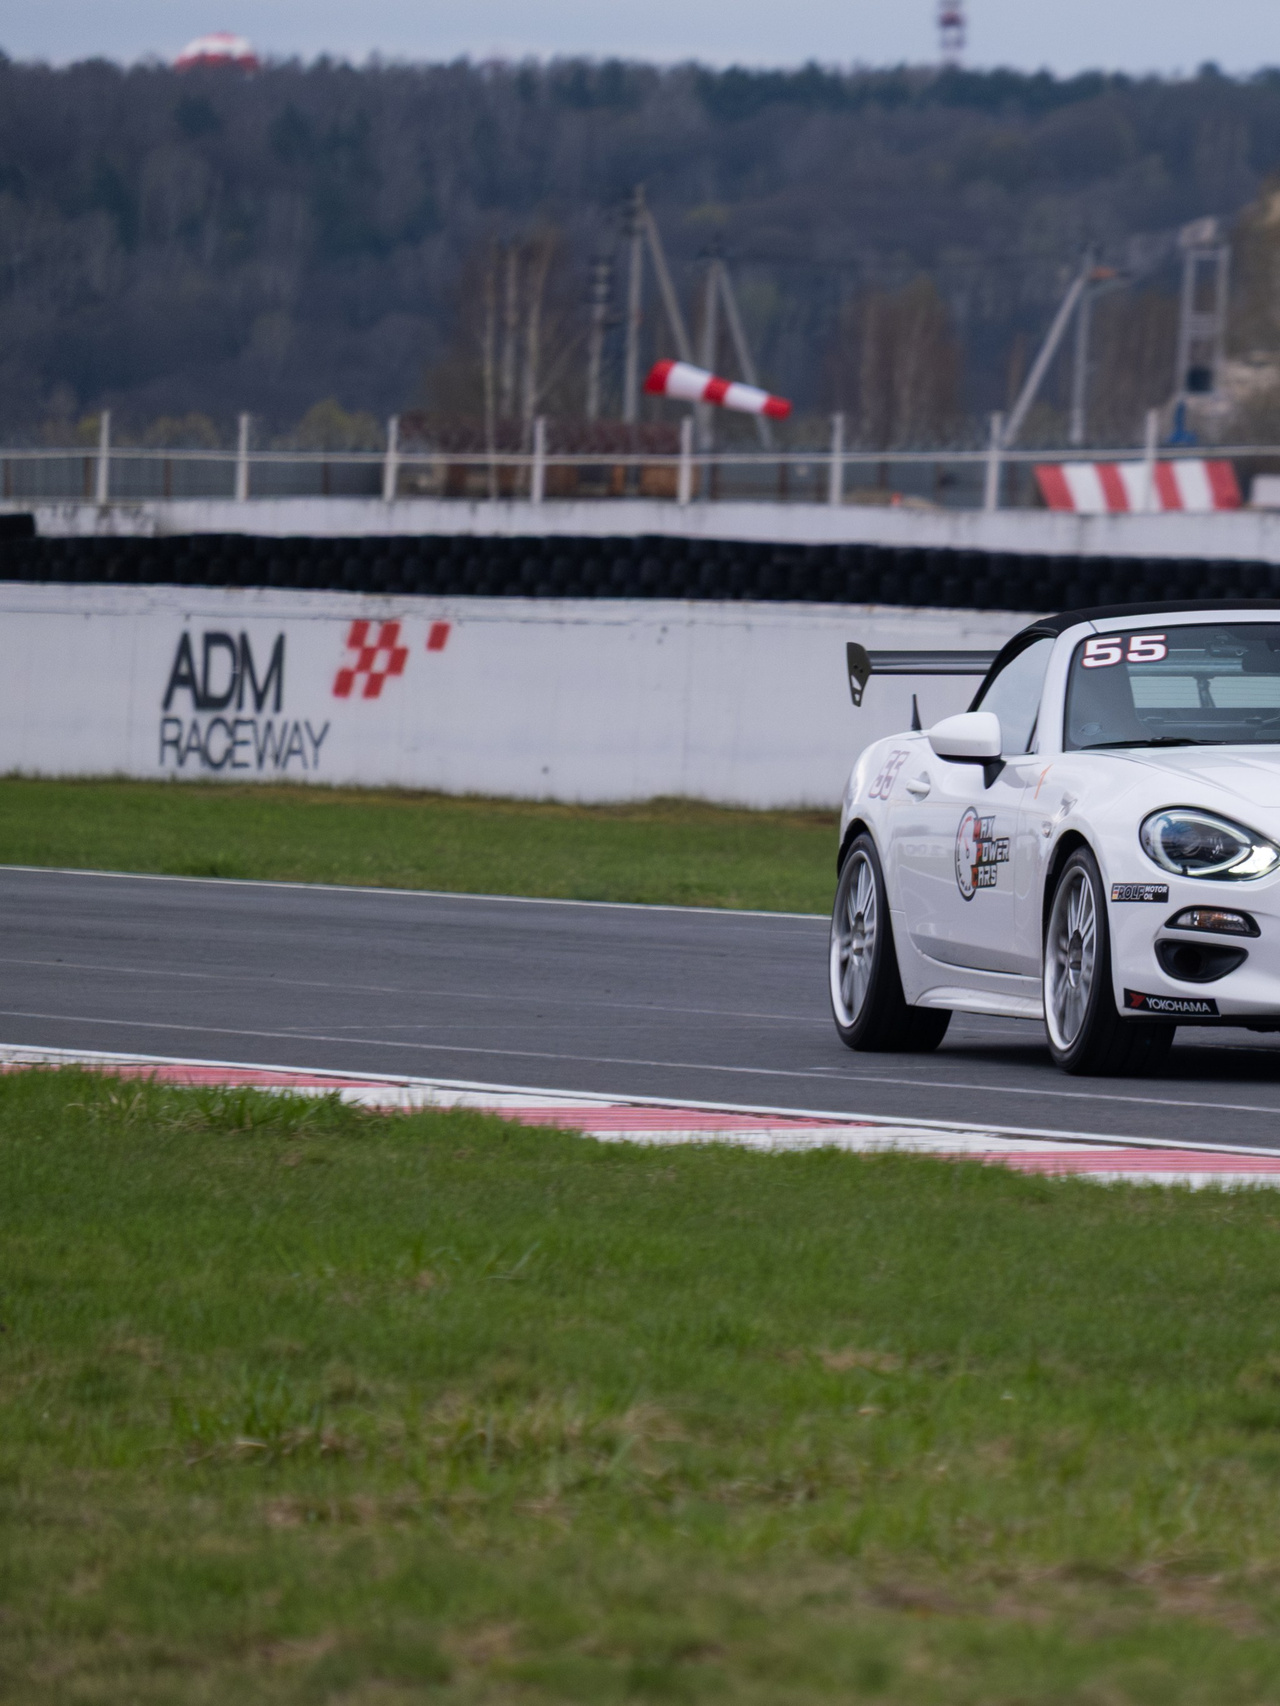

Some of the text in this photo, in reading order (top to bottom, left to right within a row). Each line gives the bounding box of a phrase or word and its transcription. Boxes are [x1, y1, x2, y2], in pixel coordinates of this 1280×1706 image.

[1082, 634, 1167, 668] 55
[162, 631, 286, 714] ADM
[159, 717, 331, 771] RACEWAY
[868, 750, 911, 801] 55
[976, 838, 1009, 863] POWER
[971, 864, 997, 888] CARS
[1117, 885, 1168, 900] ROLF MOTOR
[1143, 893, 1154, 901] OIL
[1146, 997, 1212, 1013] YOKOHAMA
